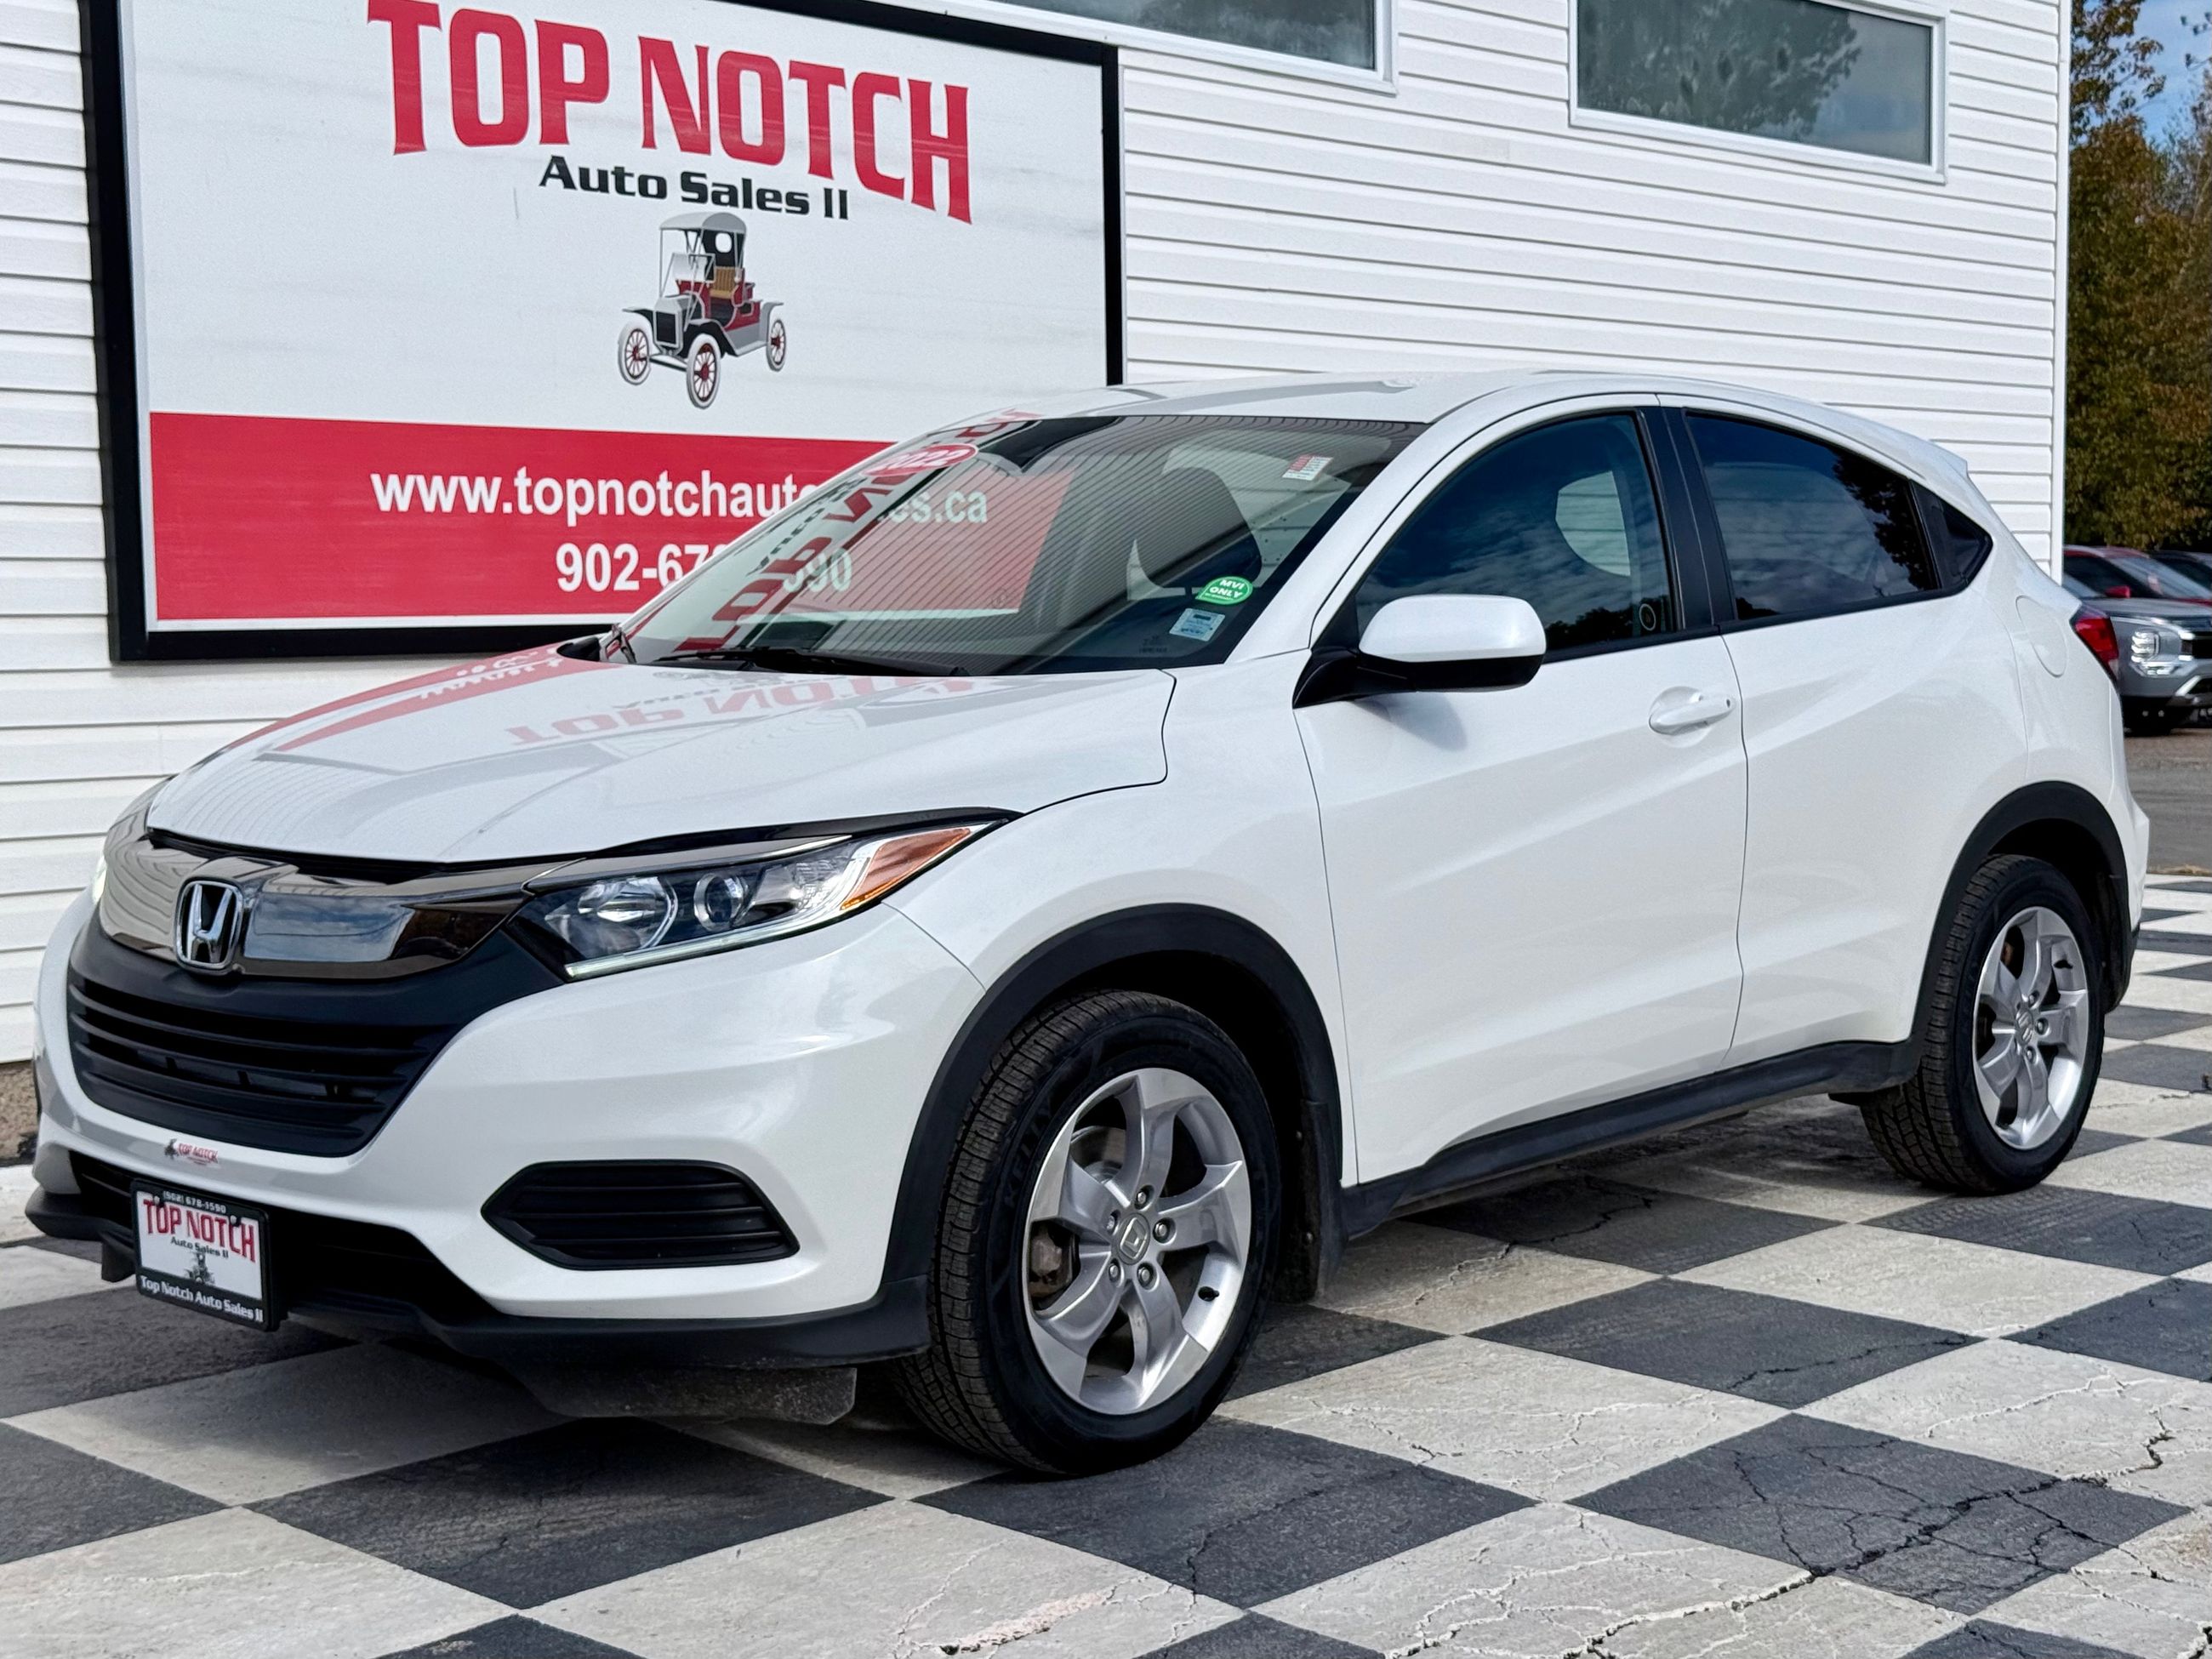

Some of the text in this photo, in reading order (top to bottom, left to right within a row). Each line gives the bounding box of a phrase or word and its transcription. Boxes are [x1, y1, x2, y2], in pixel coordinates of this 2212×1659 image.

[367, 0, 972, 225] TOP NOTCH
[538, 155, 668, 202] Auto
[681, 171, 810, 217] Sales
[1209, 586, 1243, 598] ONLY
[1219, 579, 1245, 590] MVI
[185, 1196, 226, 1214] 678-1590
[143, 1198, 256, 1263] TOP NOTCH
[170, 1236, 193, 1250] Auto
[195, 1242, 220, 1257] Sales
[140, 1274, 160, 1294] Top
[161, 1280, 194, 1302] Notch
[195, 1291, 222, 1309] Auto
[224, 1299, 254, 1320] Sales
